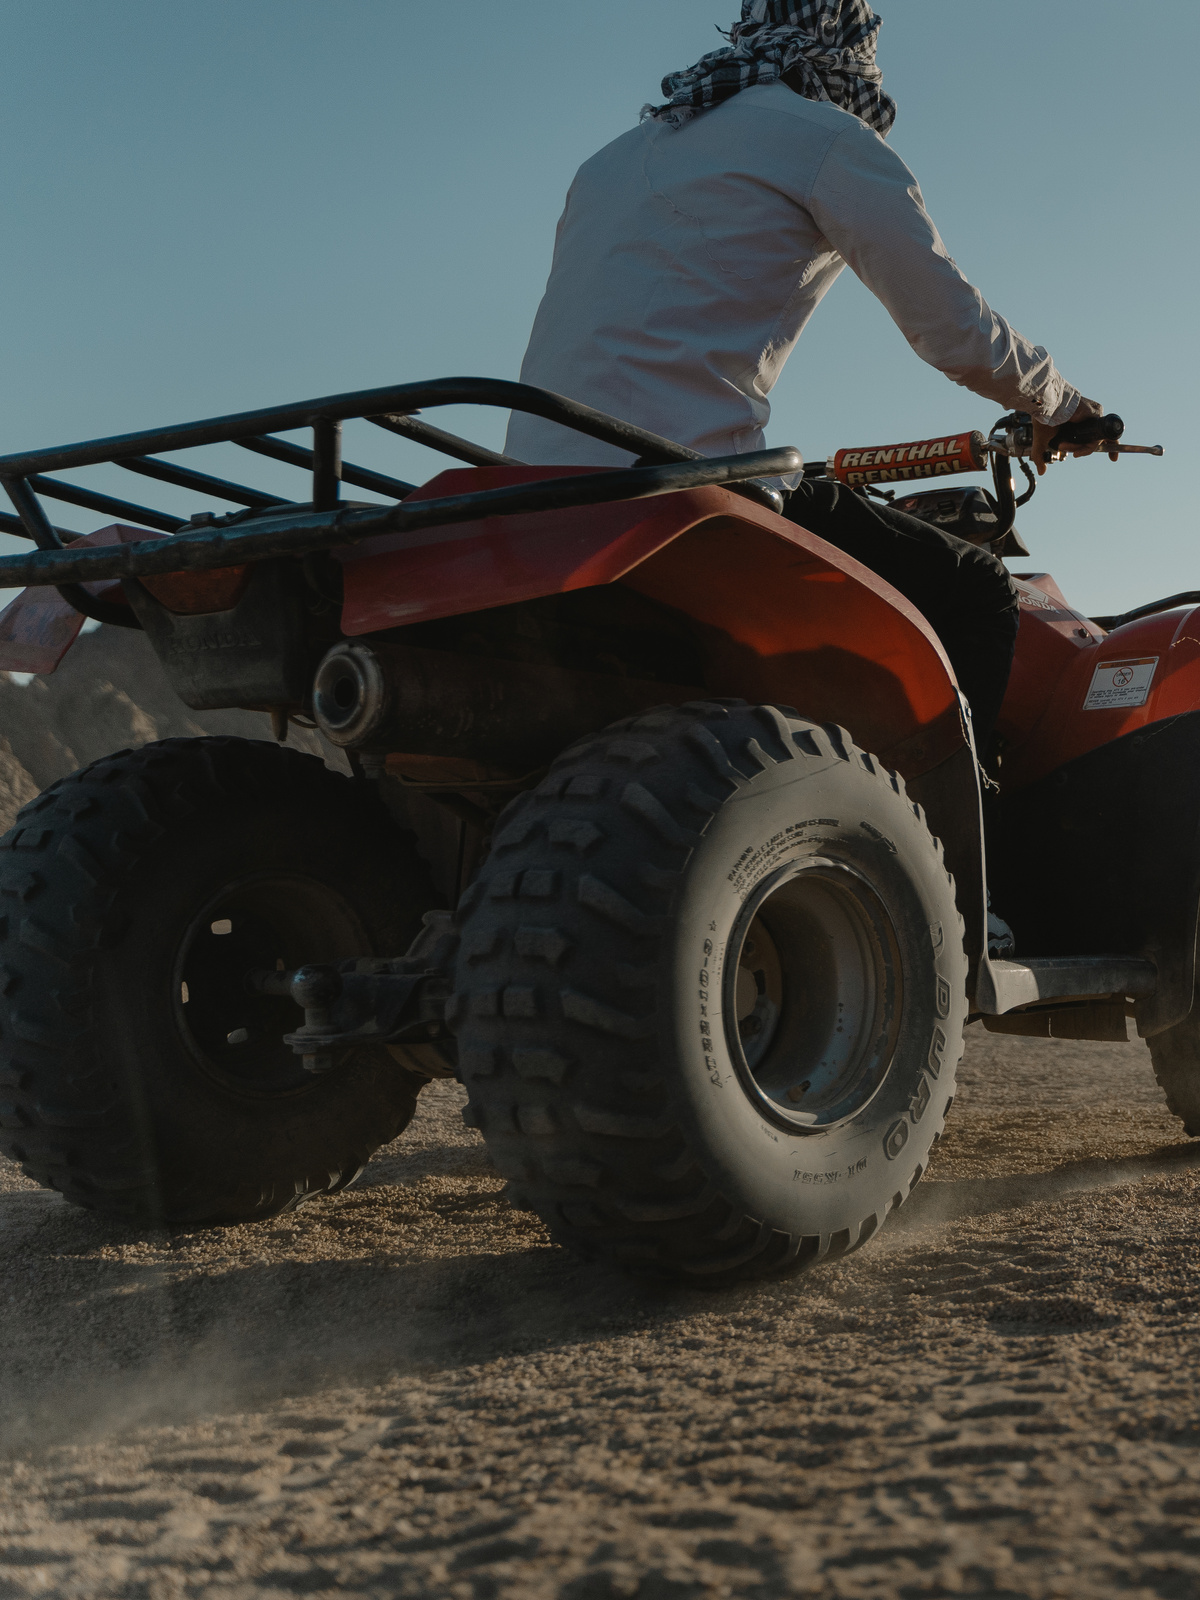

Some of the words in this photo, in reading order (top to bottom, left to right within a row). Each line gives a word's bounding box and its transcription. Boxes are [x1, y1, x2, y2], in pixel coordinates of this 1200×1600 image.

[841, 439, 962, 468] RENTHAL
[847, 459, 969, 485] RENTHAL
[883, 973, 952, 1160] DURO
